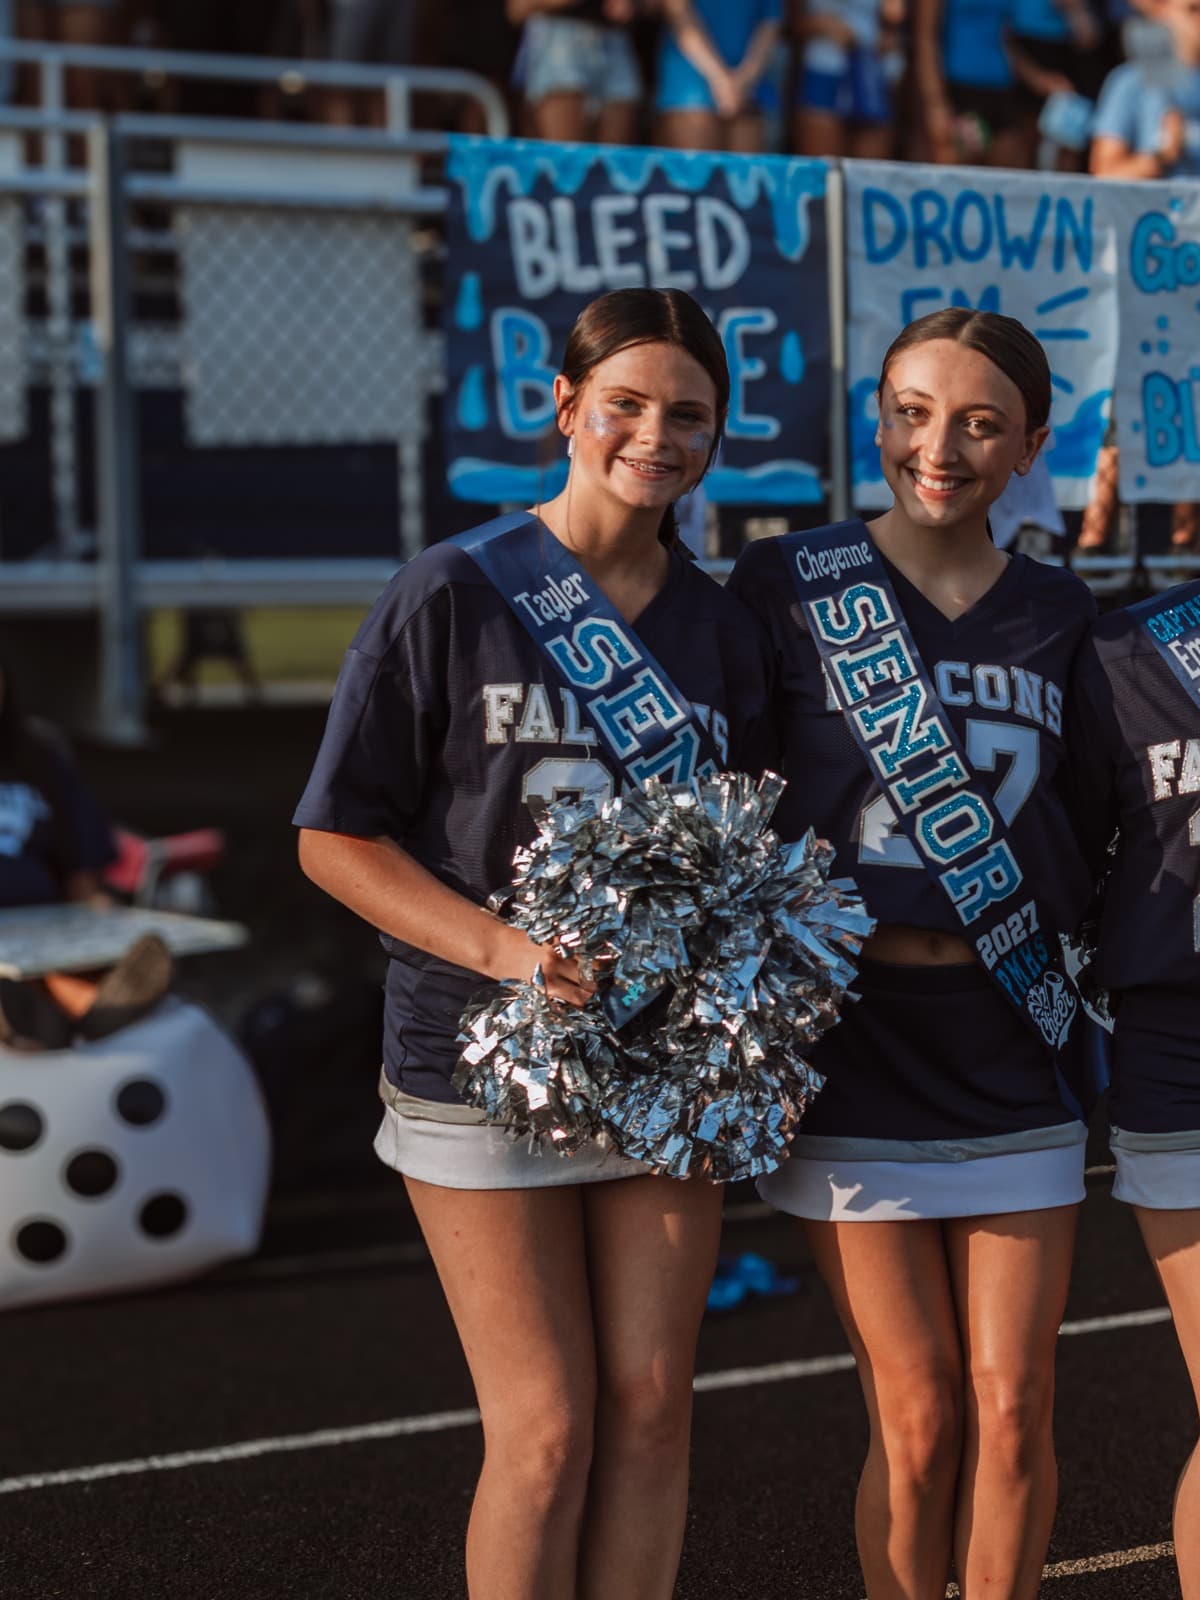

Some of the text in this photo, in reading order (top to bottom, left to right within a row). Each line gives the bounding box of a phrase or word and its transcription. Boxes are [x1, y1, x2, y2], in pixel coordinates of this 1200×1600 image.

[508, 195, 750, 299] BLEED
[861, 187, 1094, 273] DROWN
[491, 307, 780, 439] BE
[513, 571, 591, 627] Tayler
[796, 541, 873, 583] Cheyenne
[544, 616, 719, 800] SEN
[809, 581, 1024, 926] SENIOR
[976, 900, 1040, 970] 2027
